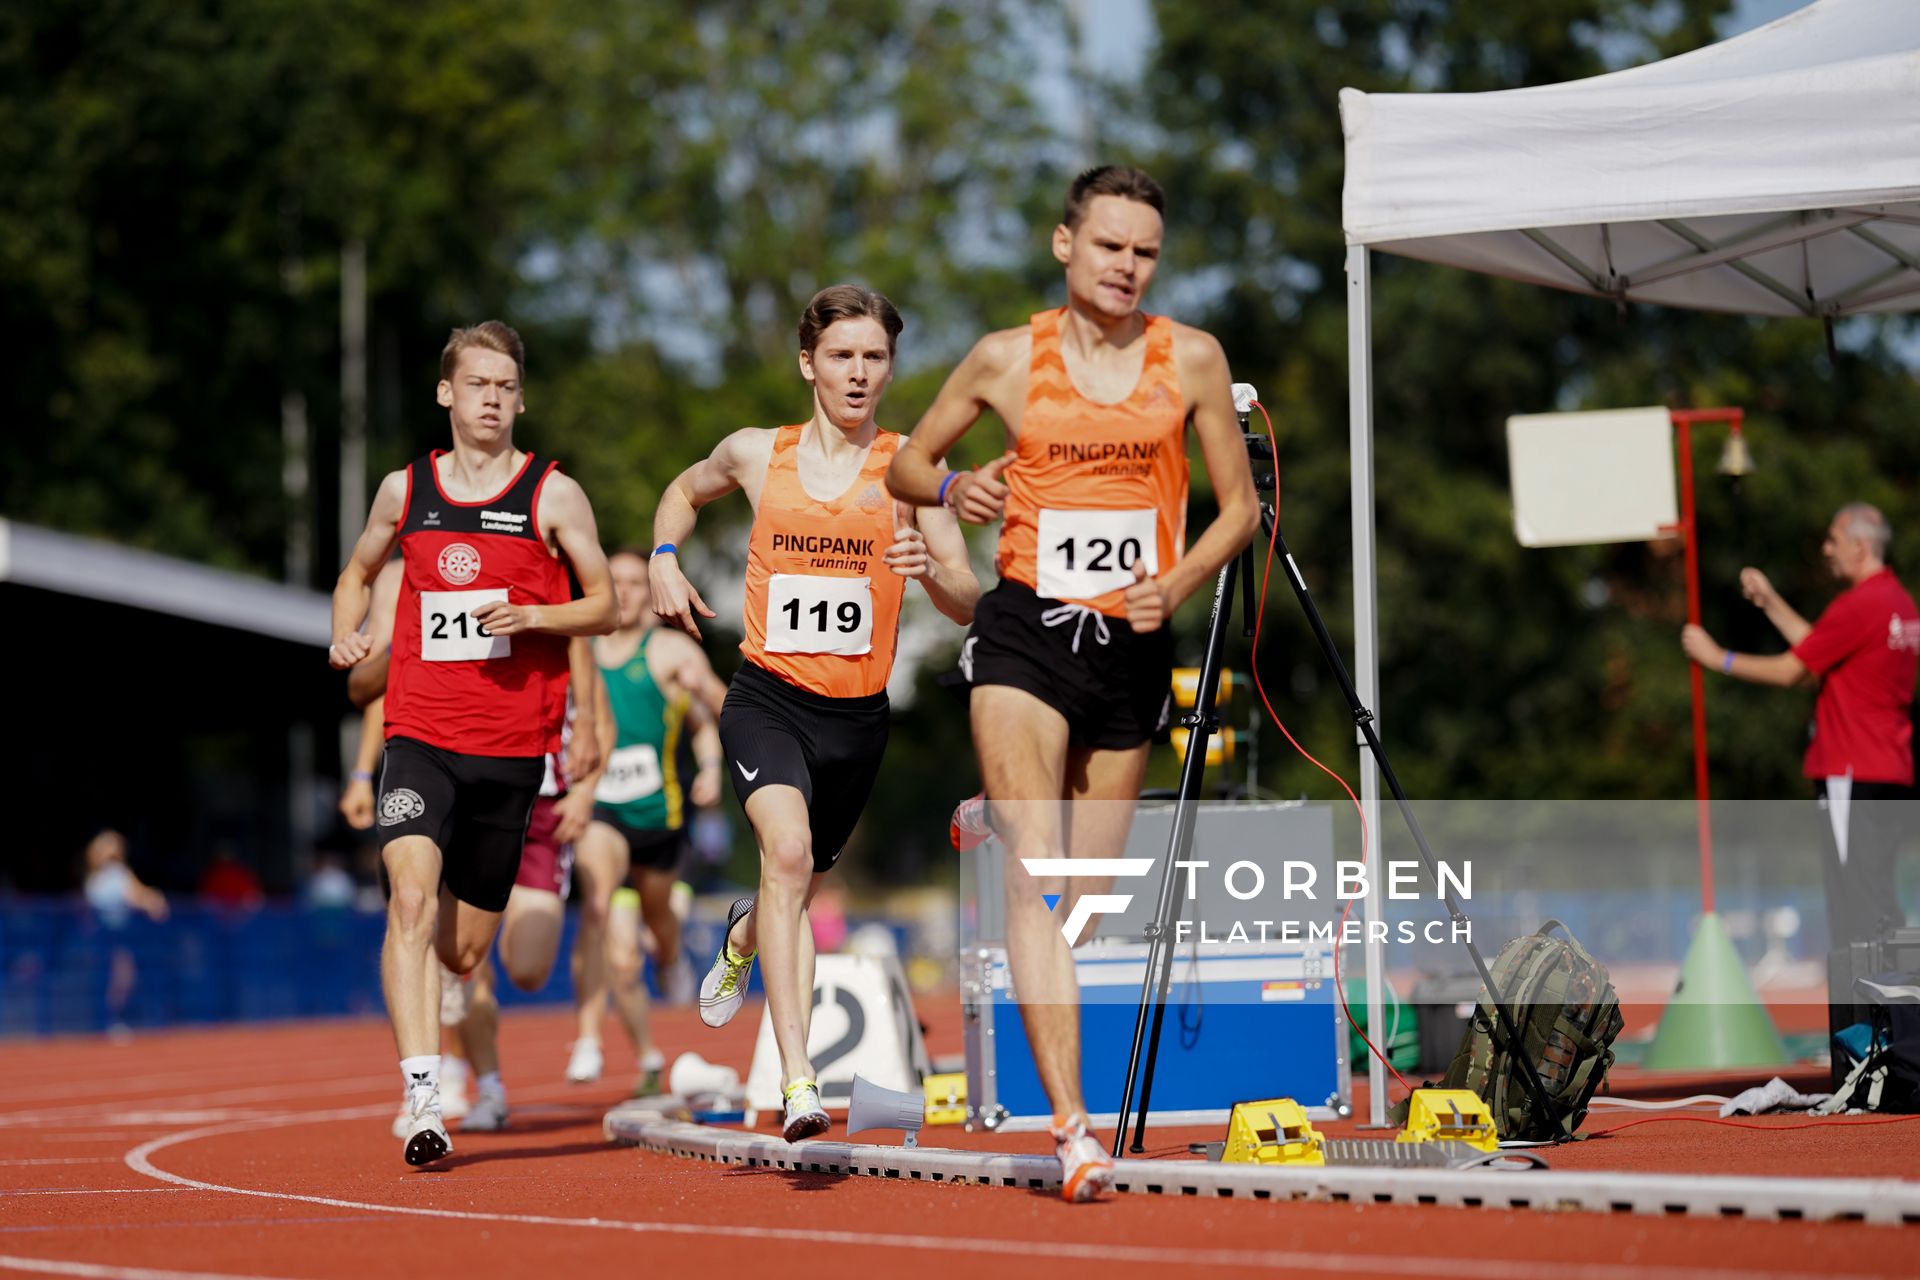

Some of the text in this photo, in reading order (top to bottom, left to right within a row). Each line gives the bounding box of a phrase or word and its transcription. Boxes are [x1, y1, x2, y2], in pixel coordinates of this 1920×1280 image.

[1048, 441, 1162, 462] PINGPANK
[1092, 463, 1152, 478] running
[772, 533, 875, 557] PINGPANK
[1055, 537, 1142, 572] 120
[810, 556, 868, 575] running
[782, 597, 862, 634] 119
[810, 985, 866, 1098] 2
